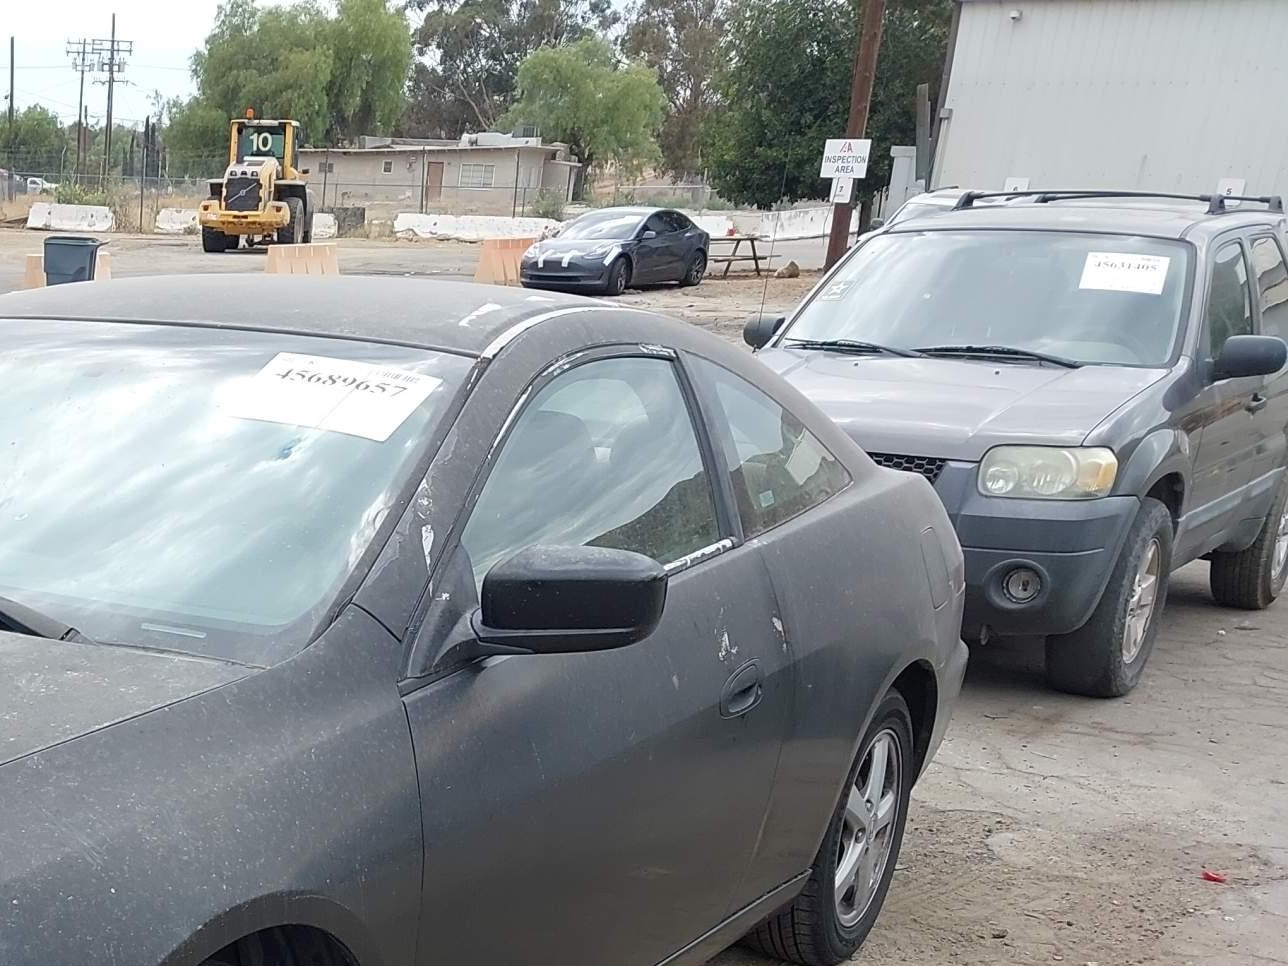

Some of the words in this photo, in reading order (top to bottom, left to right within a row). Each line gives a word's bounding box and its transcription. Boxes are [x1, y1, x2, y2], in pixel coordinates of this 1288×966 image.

[249, 132, 273, 152] 10
[824, 155, 867, 164] INSPECTION
[834, 165, 855, 174] AREA
[839, 185, 844, 193] 7
[275, 368, 408, 397] 45689657
